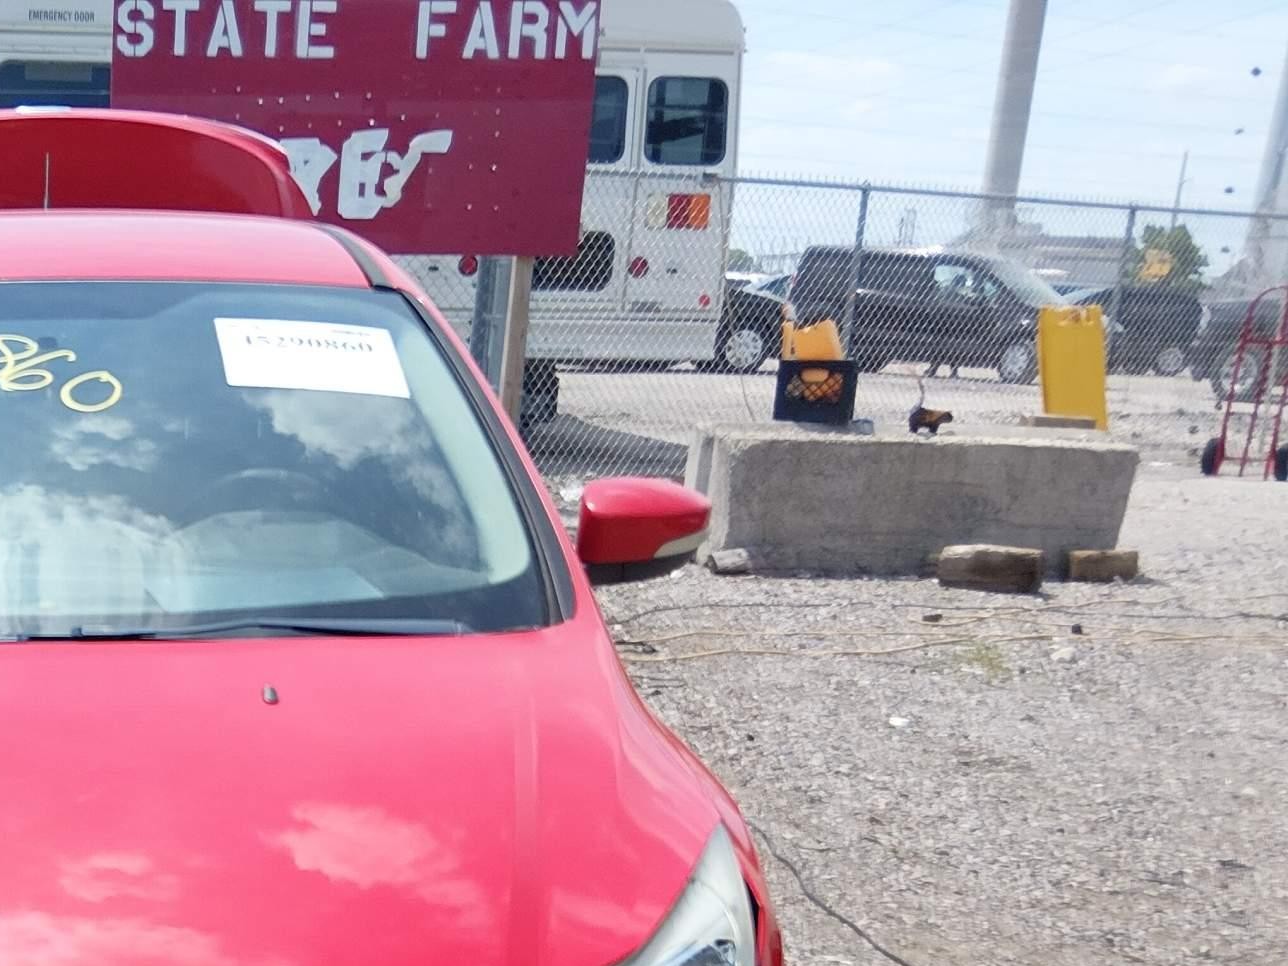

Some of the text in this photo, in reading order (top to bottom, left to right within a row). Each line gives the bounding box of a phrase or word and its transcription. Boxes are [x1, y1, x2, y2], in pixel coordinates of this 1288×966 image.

[28, 9, 95, 22] EMERGENCY DOOR
[116, 0, 596, 60] STATE FARM
